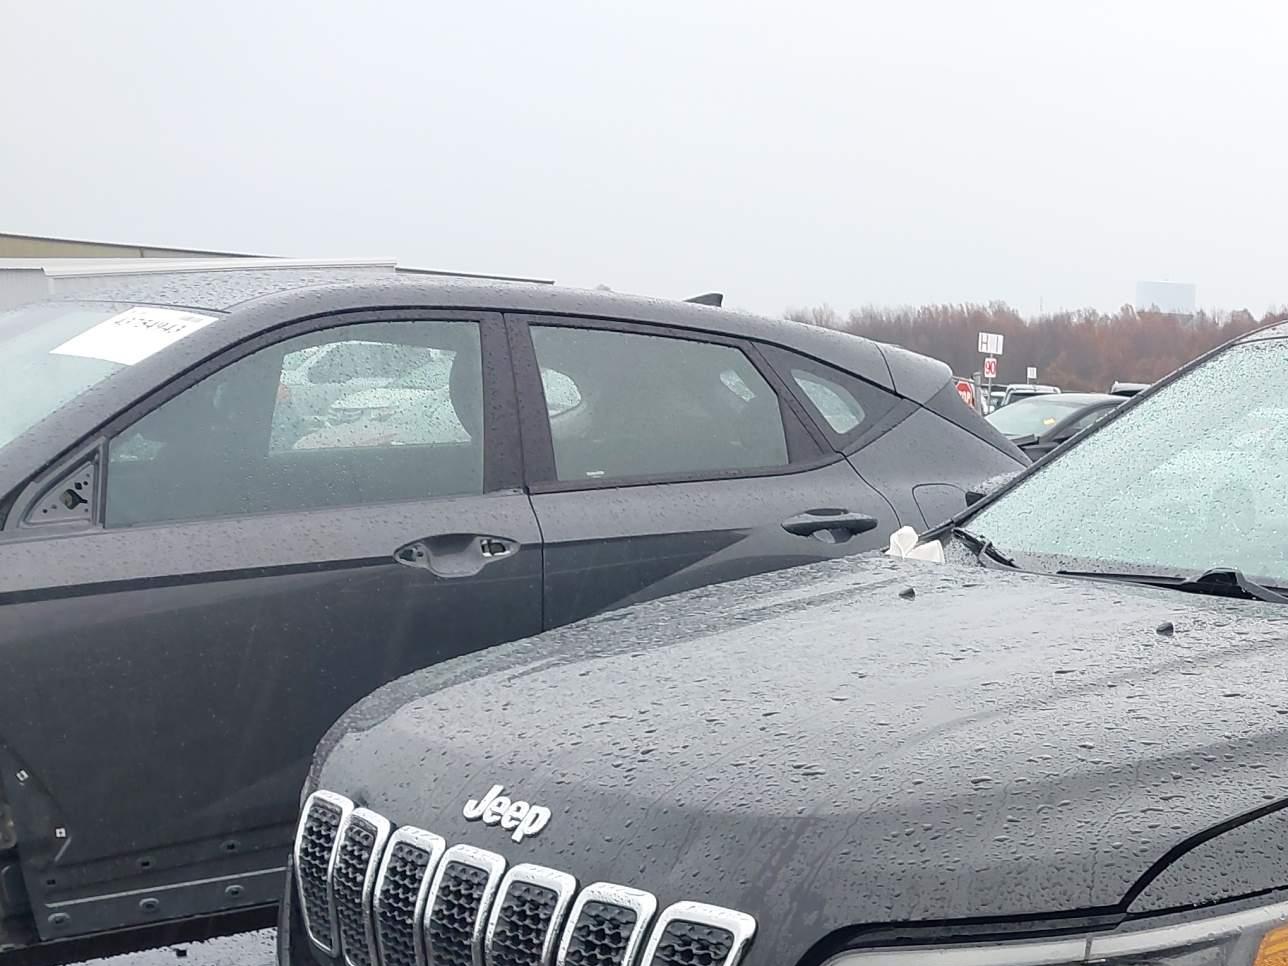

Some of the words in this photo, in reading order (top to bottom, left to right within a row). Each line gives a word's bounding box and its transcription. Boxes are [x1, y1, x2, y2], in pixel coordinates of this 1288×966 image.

[980, 334, 989, 352] H
[985, 360, 997, 375] 90
[463, 784, 552, 843] Jeep
